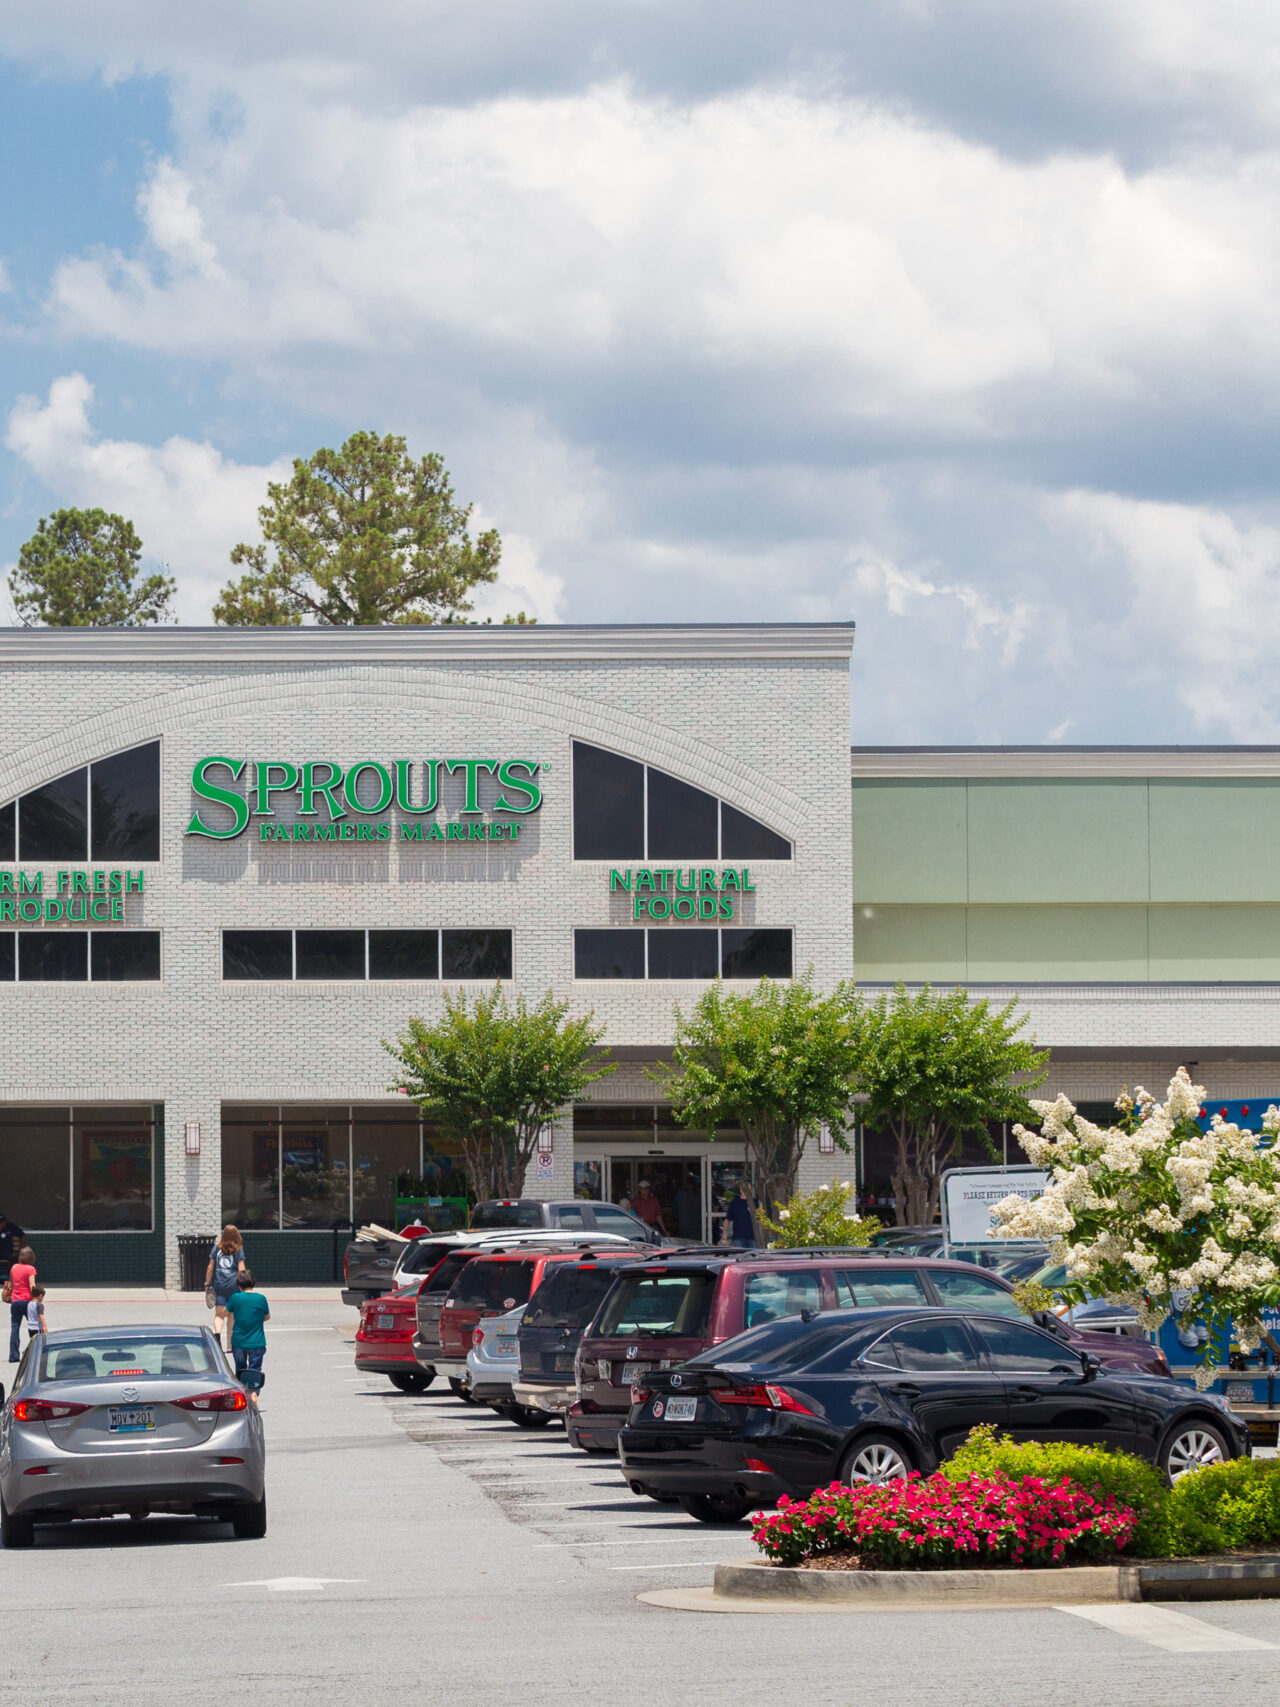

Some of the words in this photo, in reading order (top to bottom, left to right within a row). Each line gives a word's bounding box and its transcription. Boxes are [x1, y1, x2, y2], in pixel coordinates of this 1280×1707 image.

[184, 756, 543, 839] SPROUTS
[258, 823, 391, 841] FARMERS
[400, 822, 523, 840] MARKET
[57, 870, 144, 893] FRESH
[610, 869, 756, 892] NATURAL
[634, 896, 734, 919] FOODS
[963, 1191, 986, 1200] PLEASE
